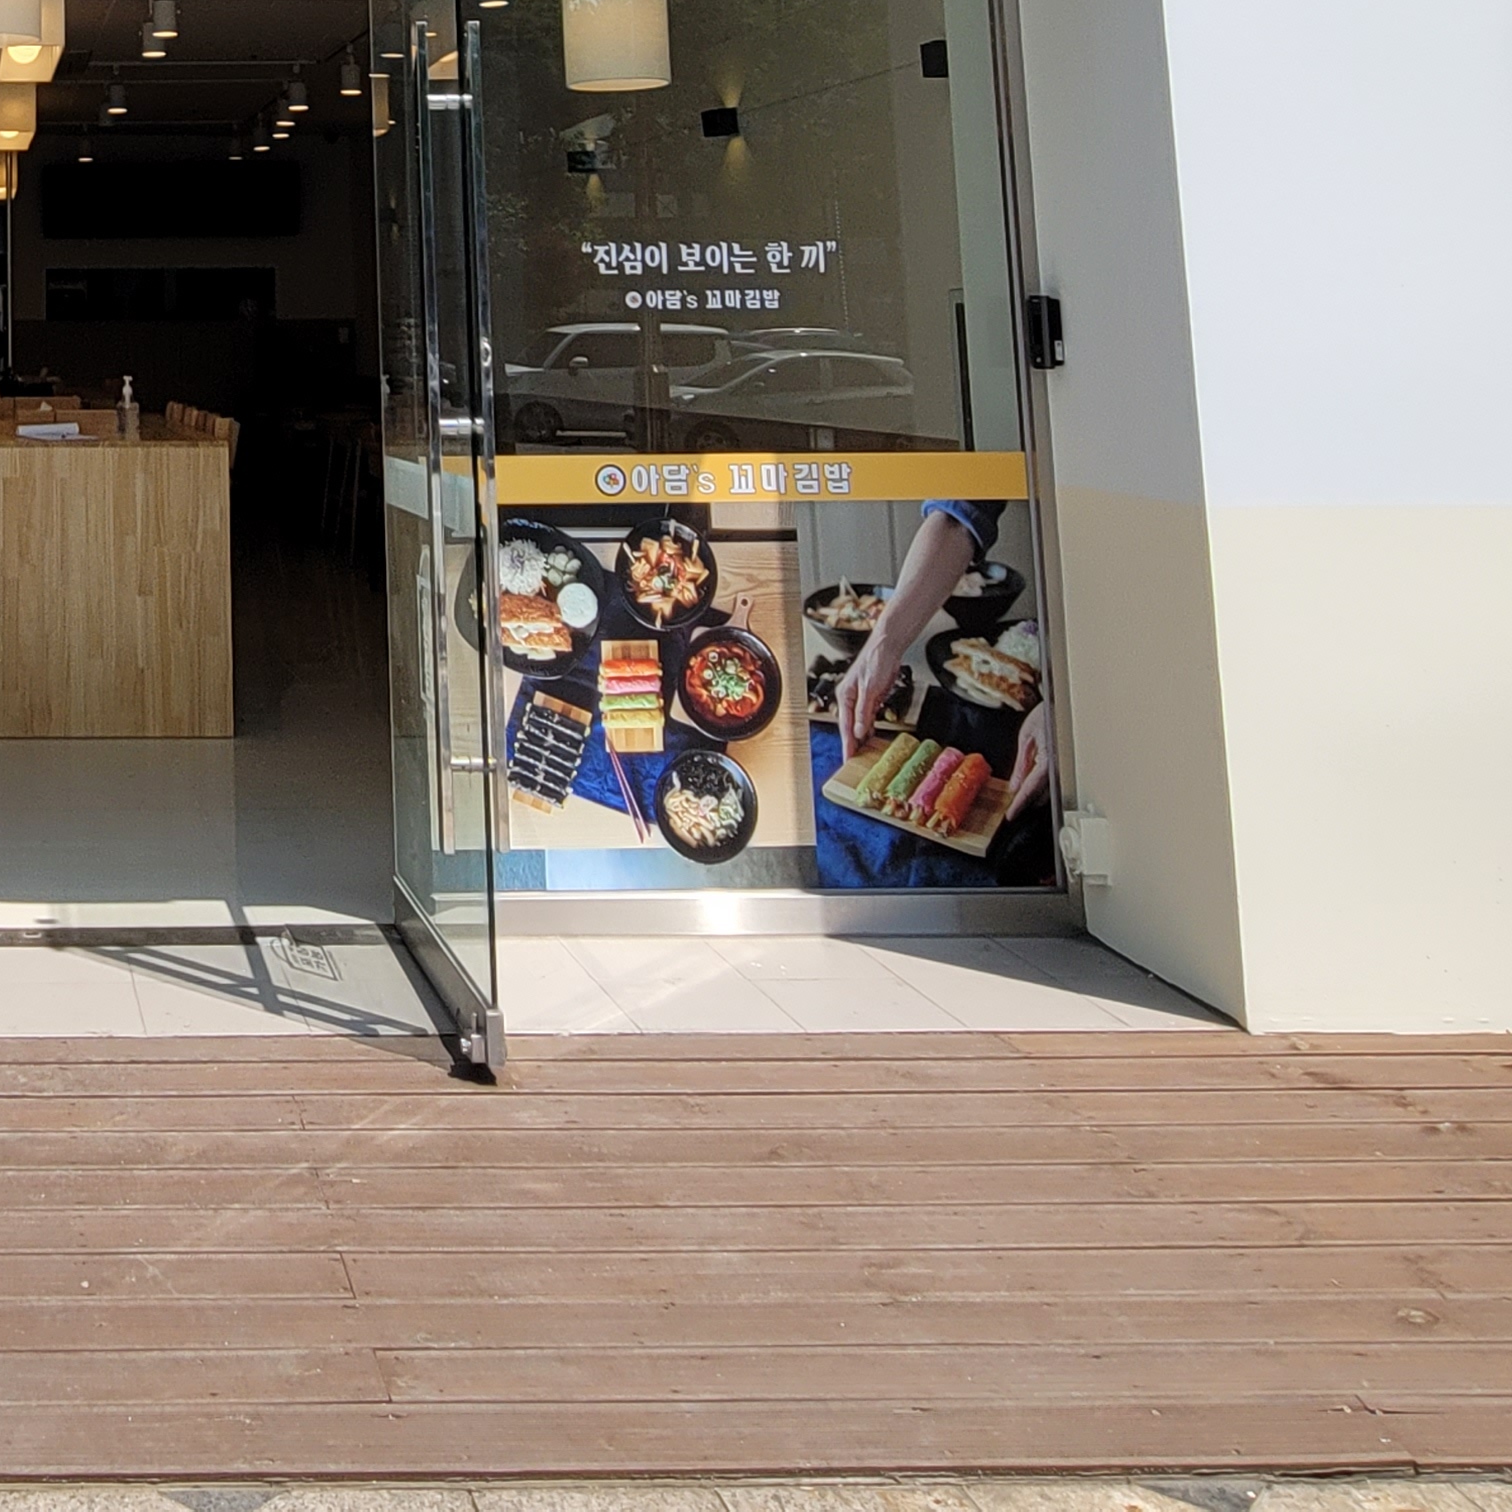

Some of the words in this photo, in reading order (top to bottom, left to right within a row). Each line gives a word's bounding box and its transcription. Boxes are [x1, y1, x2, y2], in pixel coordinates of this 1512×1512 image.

[677, 241, 758, 274] 보이는
[764, 240, 793, 273] 한
[705, 289, 781, 309] 꼬마김밥
[728, 461, 852, 495] 꼬마김밥
